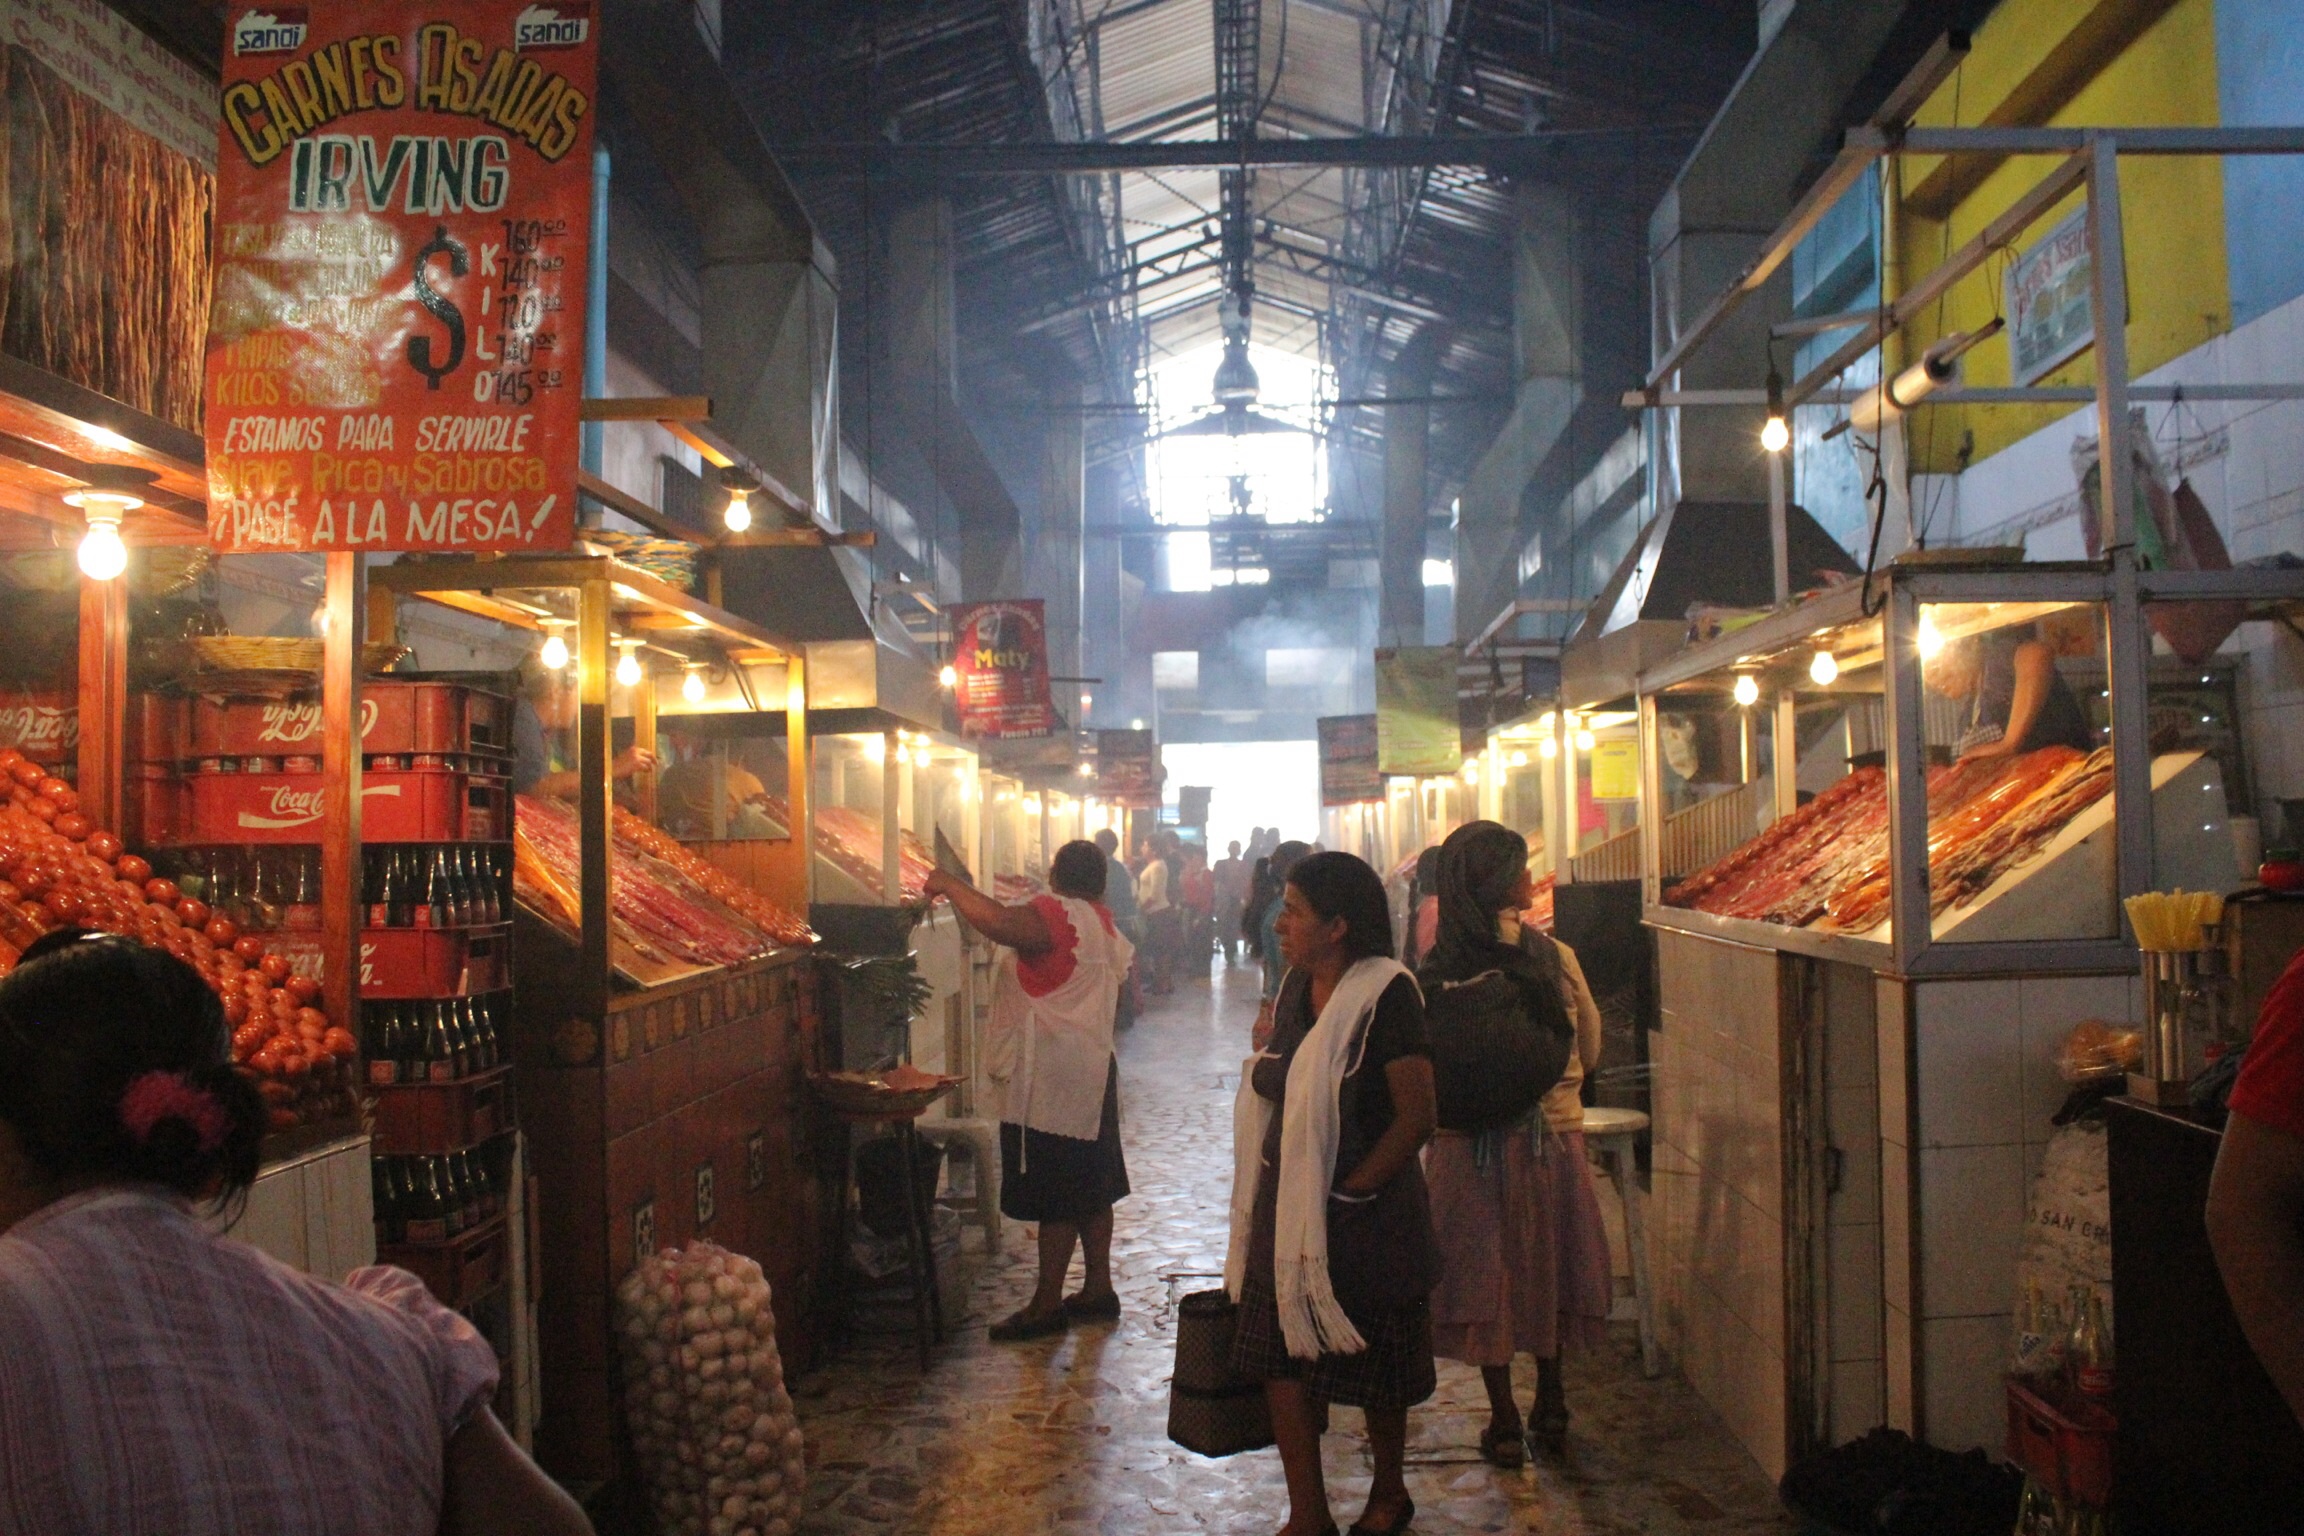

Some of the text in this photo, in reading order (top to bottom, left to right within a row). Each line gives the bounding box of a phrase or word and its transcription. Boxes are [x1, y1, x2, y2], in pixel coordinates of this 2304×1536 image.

[222, 34, 405, 168] CARNES
[416, 20, 588, 163] ASADAS
[288, 133, 510, 216] IRVING
[216, 371, 280, 407] KILOS
[224, 414, 534, 454] ESTAMOS PARA SERVIRLE
[413, 451, 547, 494] Sabrosa
[312, 499, 336, 545] A
[346, 498, 388, 543] LA
[405, 494, 558, 544] MESA!
[974, 647, 1030, 672] Maty
